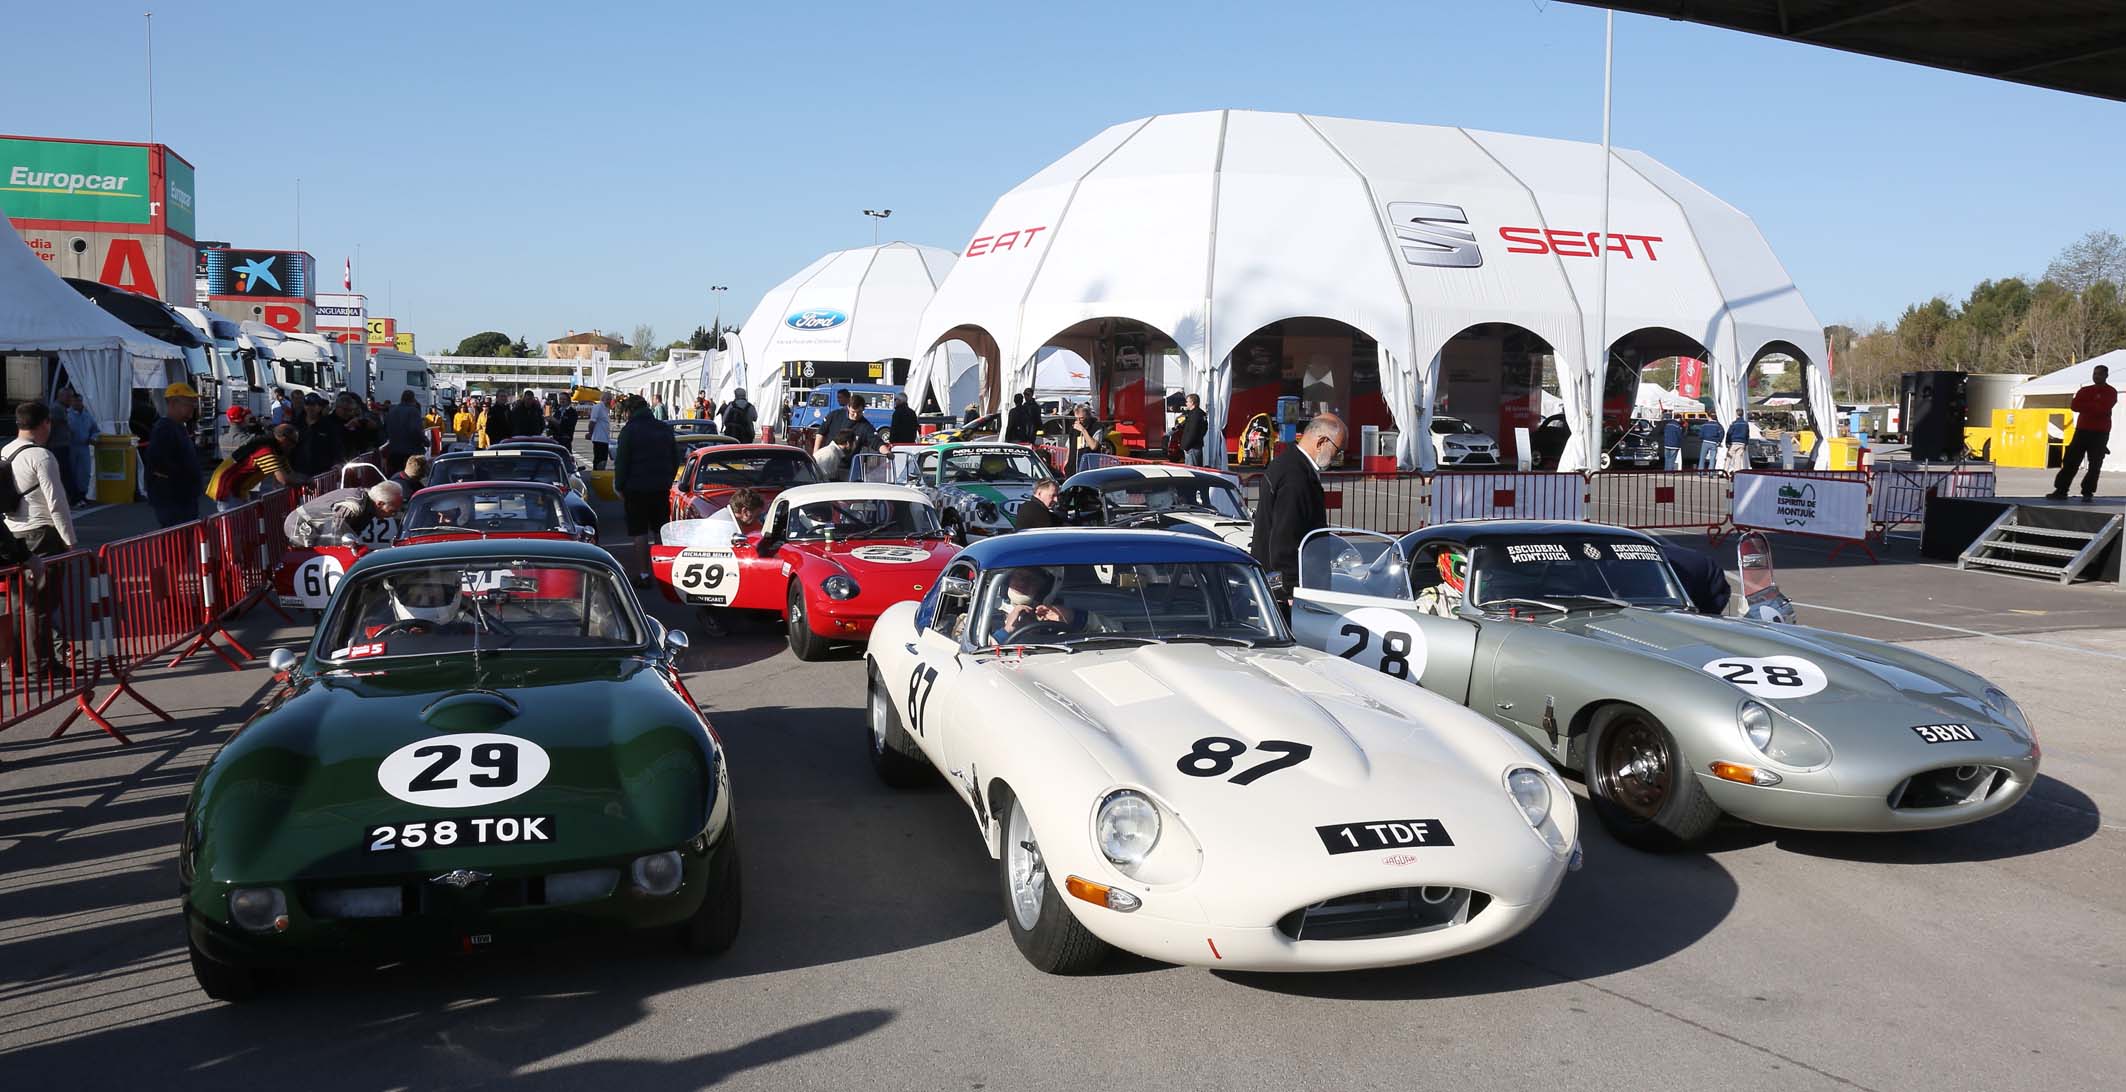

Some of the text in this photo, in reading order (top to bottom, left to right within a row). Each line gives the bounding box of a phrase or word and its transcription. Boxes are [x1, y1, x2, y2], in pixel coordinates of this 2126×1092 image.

[10, 166, 128, 194] Europcar
[1499, 226, 1663, 261] SEAT
[99, 239, 160, 300] A
[316, 307, 359, 316] NGUARDIA
[796, 311, 837, 328] Ford
[1506, 544, 1567, 555] ESCUDERIA
[1510, 552, 1571, 563] MONTJUICH
[681, 563, 724, 589] 59
[1339, 624, 1412, 681] 28
[1718, 663, 1804, 687] 28
[908, 662, 939, 738] 87
[1915, 724, 1976, 742] 3BXV
[408, 742, 519, 793] 29
[1176, 736, 1313, 786] 87
[370, 816, 549, 852] 258 TOK
[1340, 822, 1429, 848] 1 TDF
